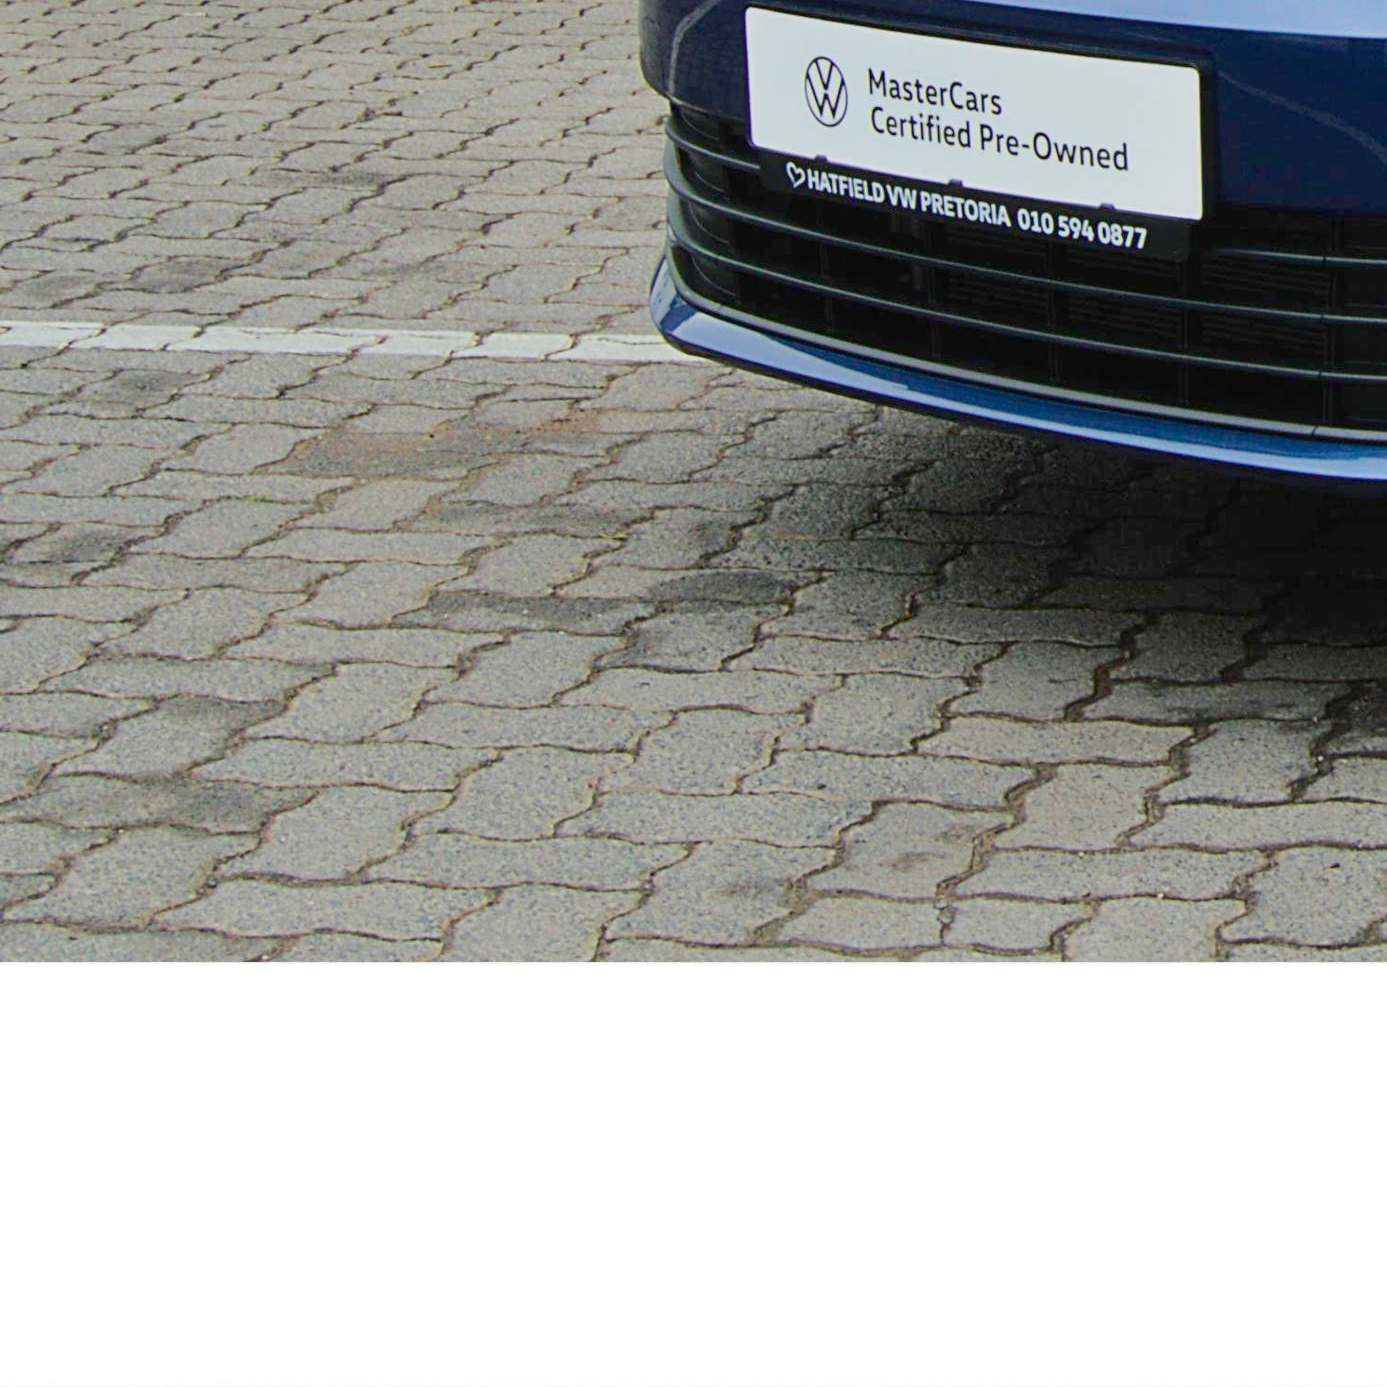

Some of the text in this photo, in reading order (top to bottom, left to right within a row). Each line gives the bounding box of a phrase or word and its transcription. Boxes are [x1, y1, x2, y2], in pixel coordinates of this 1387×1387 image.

[867, 68, 1002, 115] MasterCars
[871, 106, 1128, 171] Certified Pre-Owned
[807, 168, 1148, 249] HATFIELD VW PRETORIA 010 594 0877
